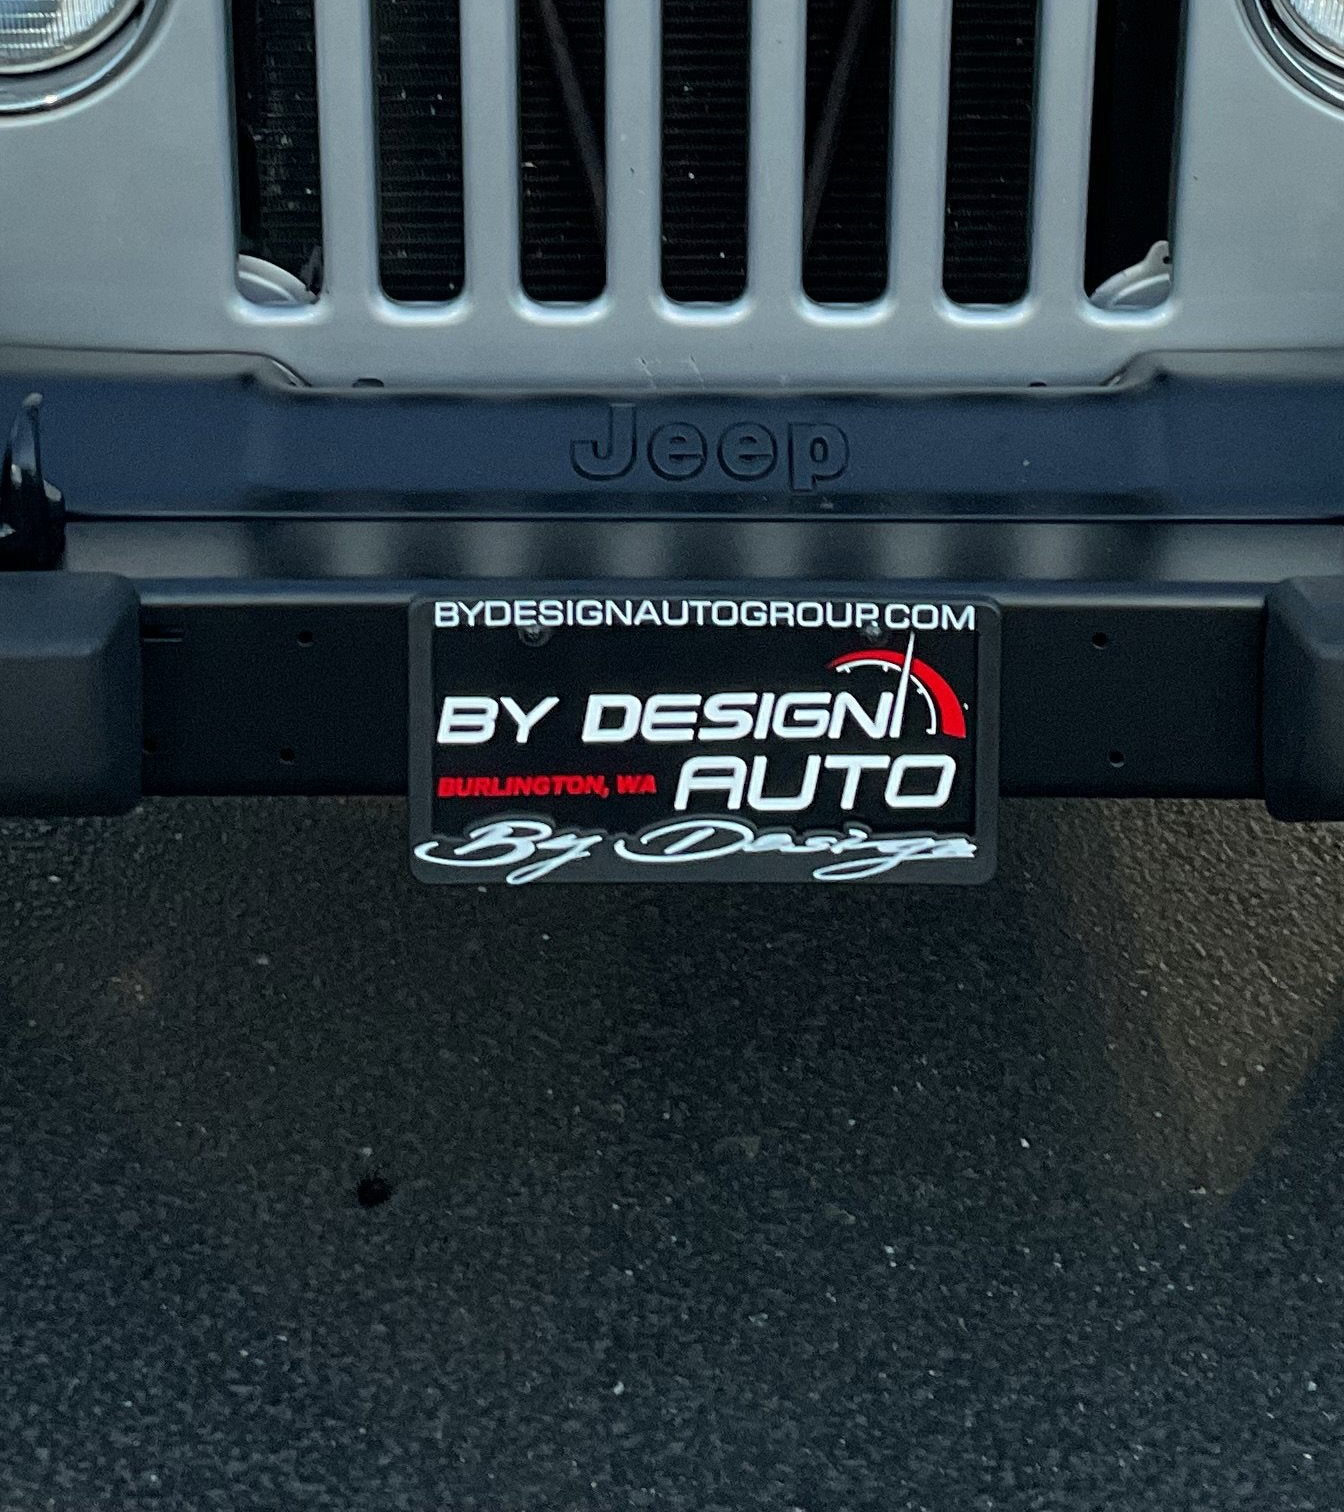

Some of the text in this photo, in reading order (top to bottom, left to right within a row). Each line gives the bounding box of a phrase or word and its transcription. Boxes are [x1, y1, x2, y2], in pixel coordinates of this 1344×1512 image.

[570, 402, 850, 496] Jeep
[434, 599, 976, 631] BYDESIGNAUTOGROUP.COM
[436, 691, 895, 744] BY DESIGN
[437, 774, 657, 798] BURLINGTON, WA
[674, 754, 957, 811] AUTO
[414, 819, 977, 884] By Design
